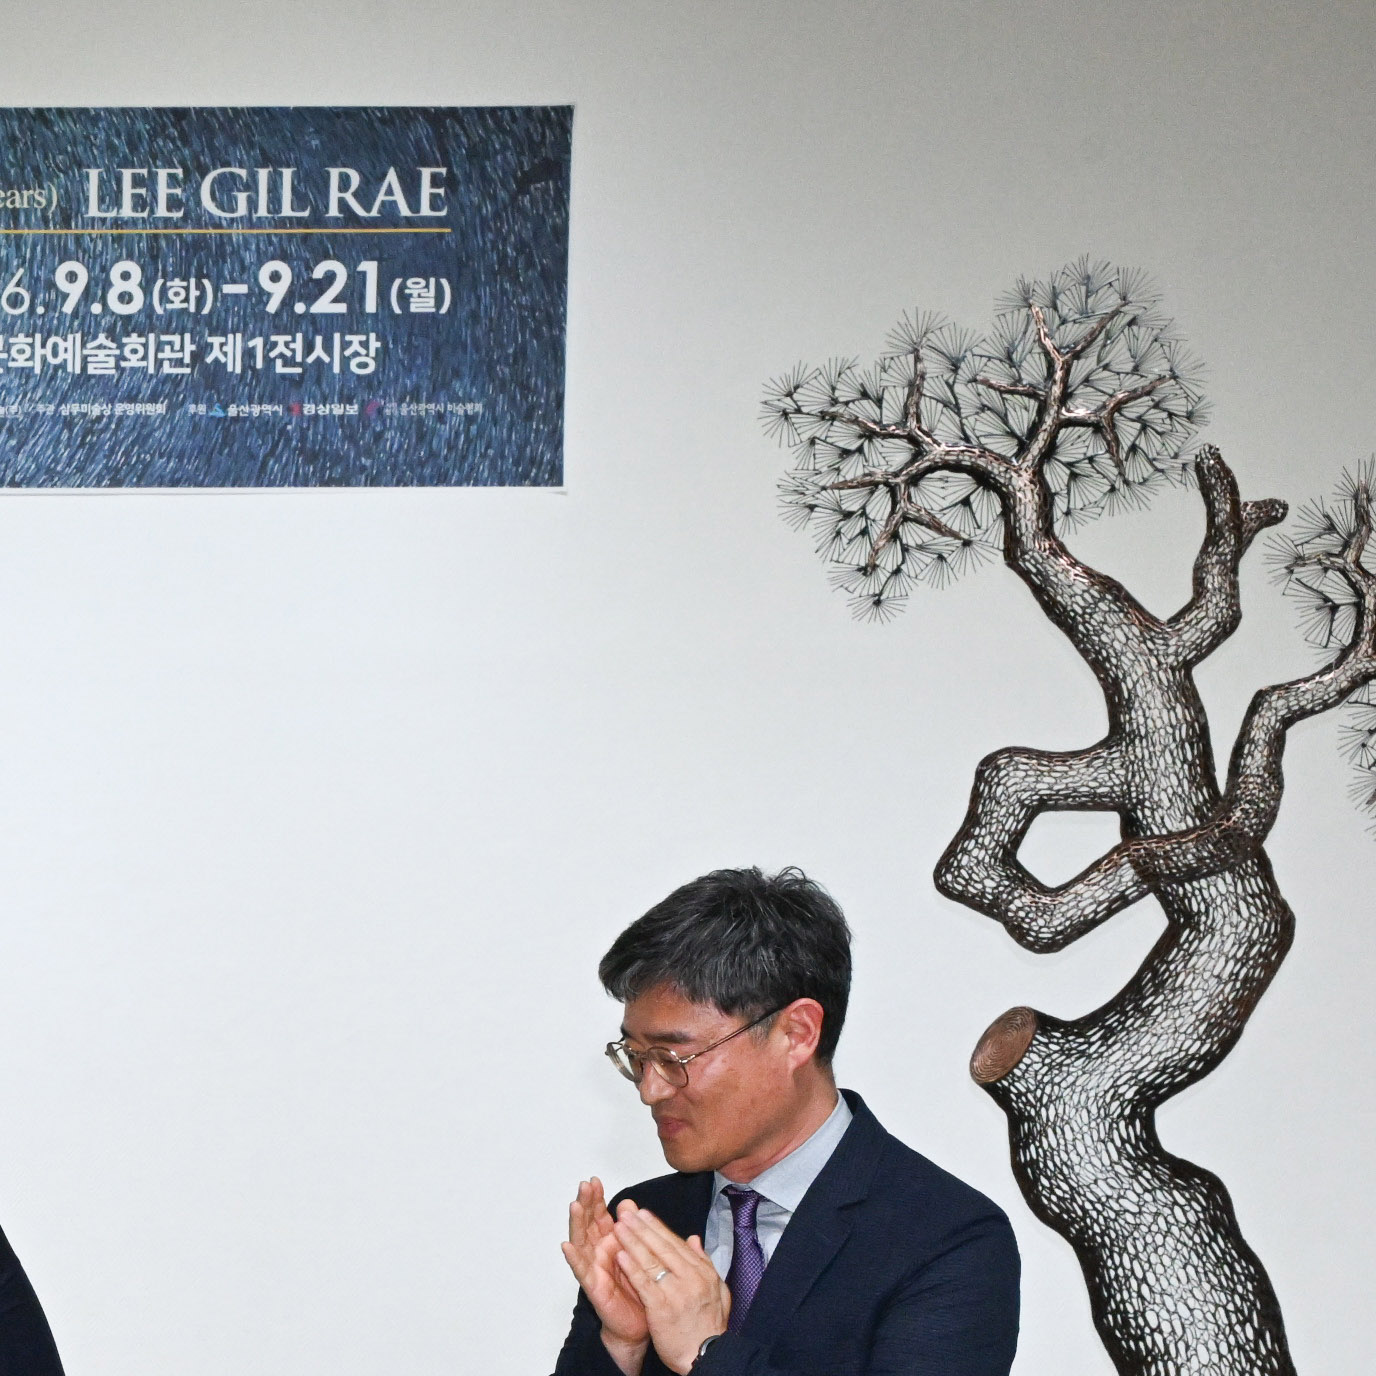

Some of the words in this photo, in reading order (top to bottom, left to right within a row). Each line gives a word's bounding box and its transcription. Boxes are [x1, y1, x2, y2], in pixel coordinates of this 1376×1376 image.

[82, 167, 185, 218] LEE
[200, 166, 310, 218] GIL
[324, 166, 448, 217] RAE
[206, 333, 381, 375] 제1전시장
[60, 403, 112, 416] 삼두미술상
[227, 403, 283, 417] 울산광역시
[303, 403, 359, 416] 경상일보
